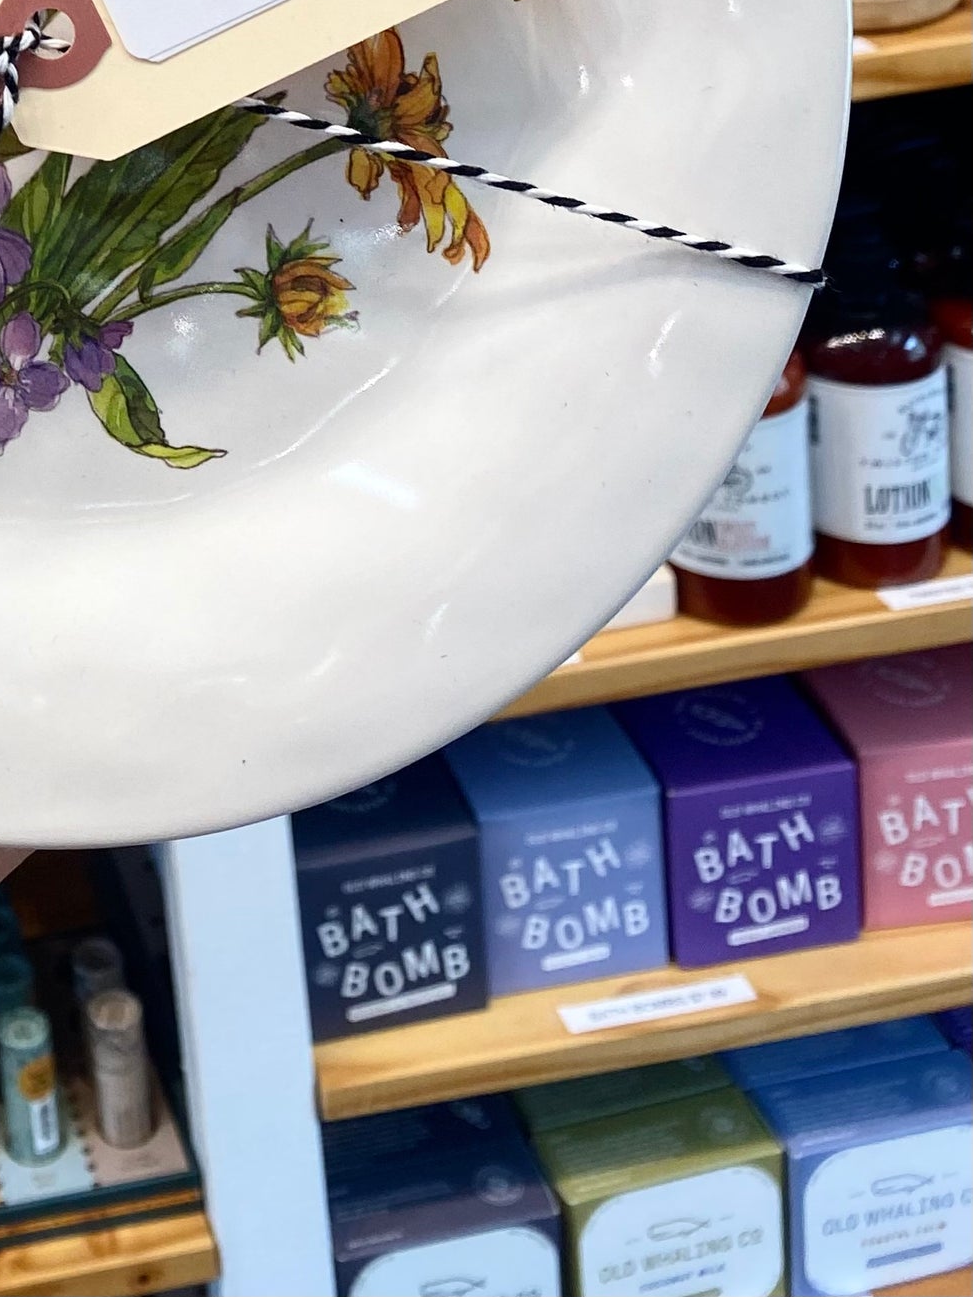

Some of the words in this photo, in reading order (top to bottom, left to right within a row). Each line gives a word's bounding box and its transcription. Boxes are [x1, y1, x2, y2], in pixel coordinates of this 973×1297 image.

[864, 477, 933, 516] LOTION
[879, 787, 973, 846] BAT
[499, 837, 622, 910] BATH
[694, 811, 815, 884] BATH
[317, 881, 440, 958] BATH
[521, 896, 650, 951] BOMB
[715, 869, 843, 924] BOMB
[340, 938, 471, 1000] BOMB
[822, 1213, 860, 1237] OLD
[863, 1191, 956, 1229] WHALING
[598, 1258, 637, 1285] OLD
[641, 1235, 734, 1273] WHALING
